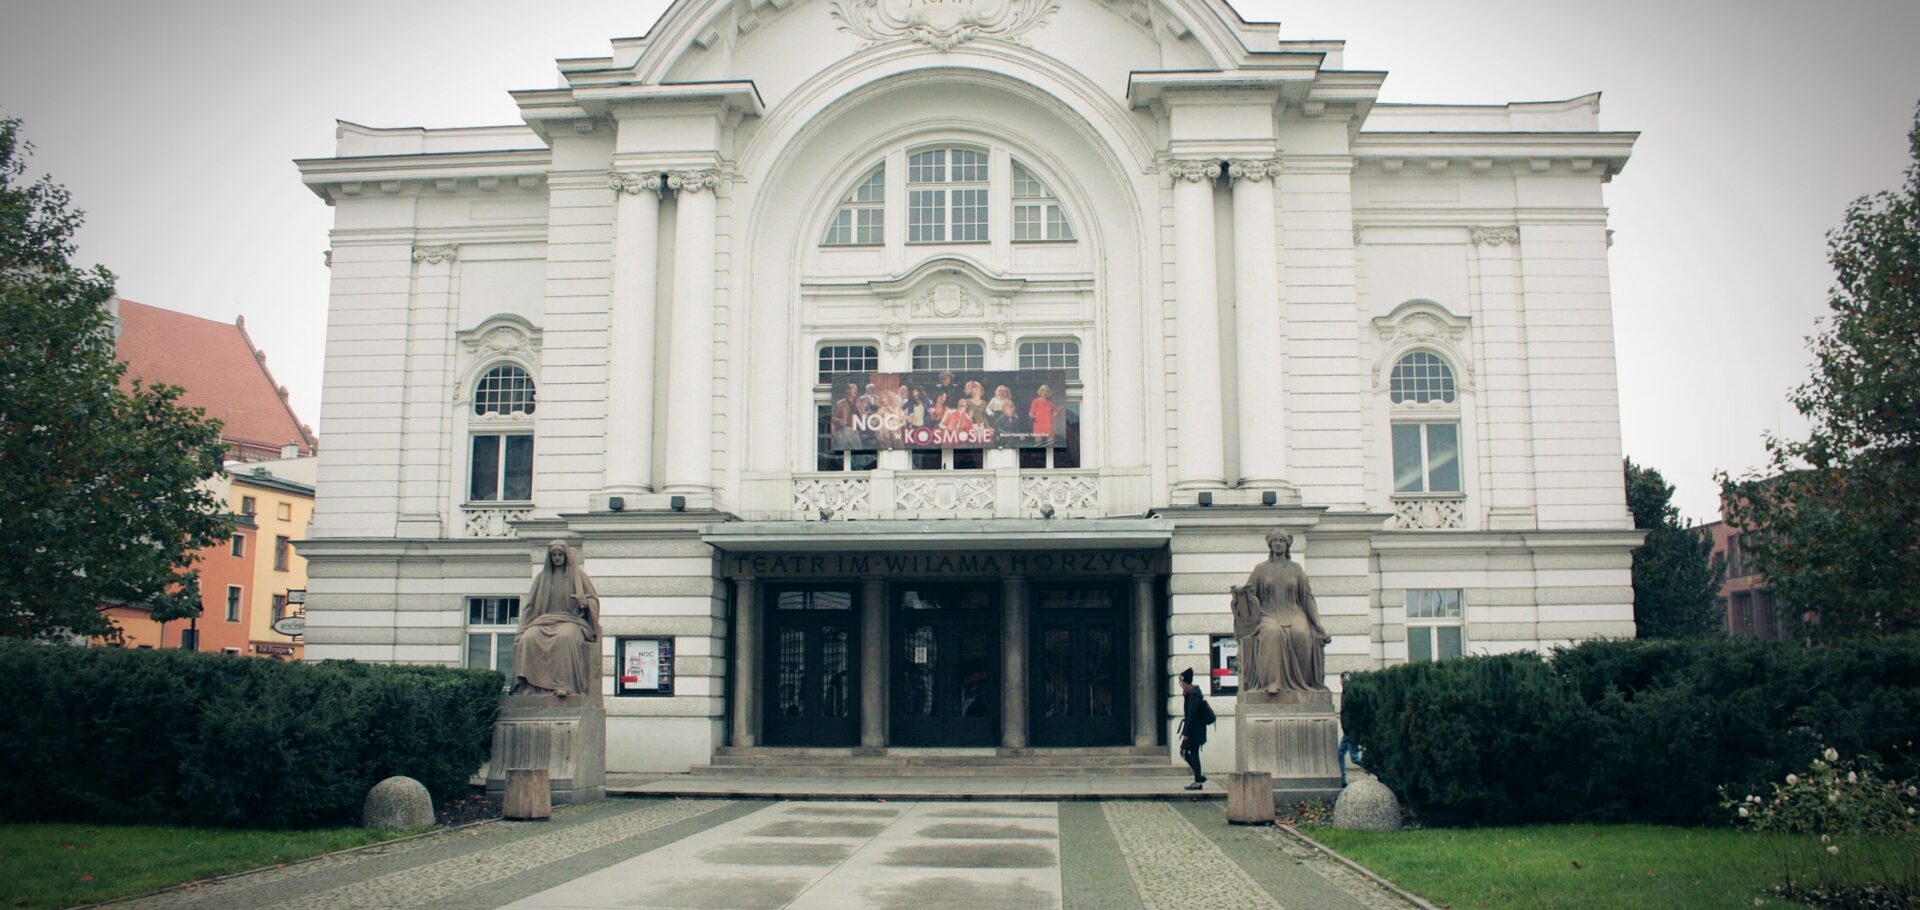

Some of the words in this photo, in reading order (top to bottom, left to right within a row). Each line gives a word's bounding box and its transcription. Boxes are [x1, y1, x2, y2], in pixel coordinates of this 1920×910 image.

[852, 414, 900, 431] NOC
[733, 555, 825, 573] TEATR
[885, 554, 999, 573] WILAMA
[1011, 553, 1155, 572] HORZYCY
